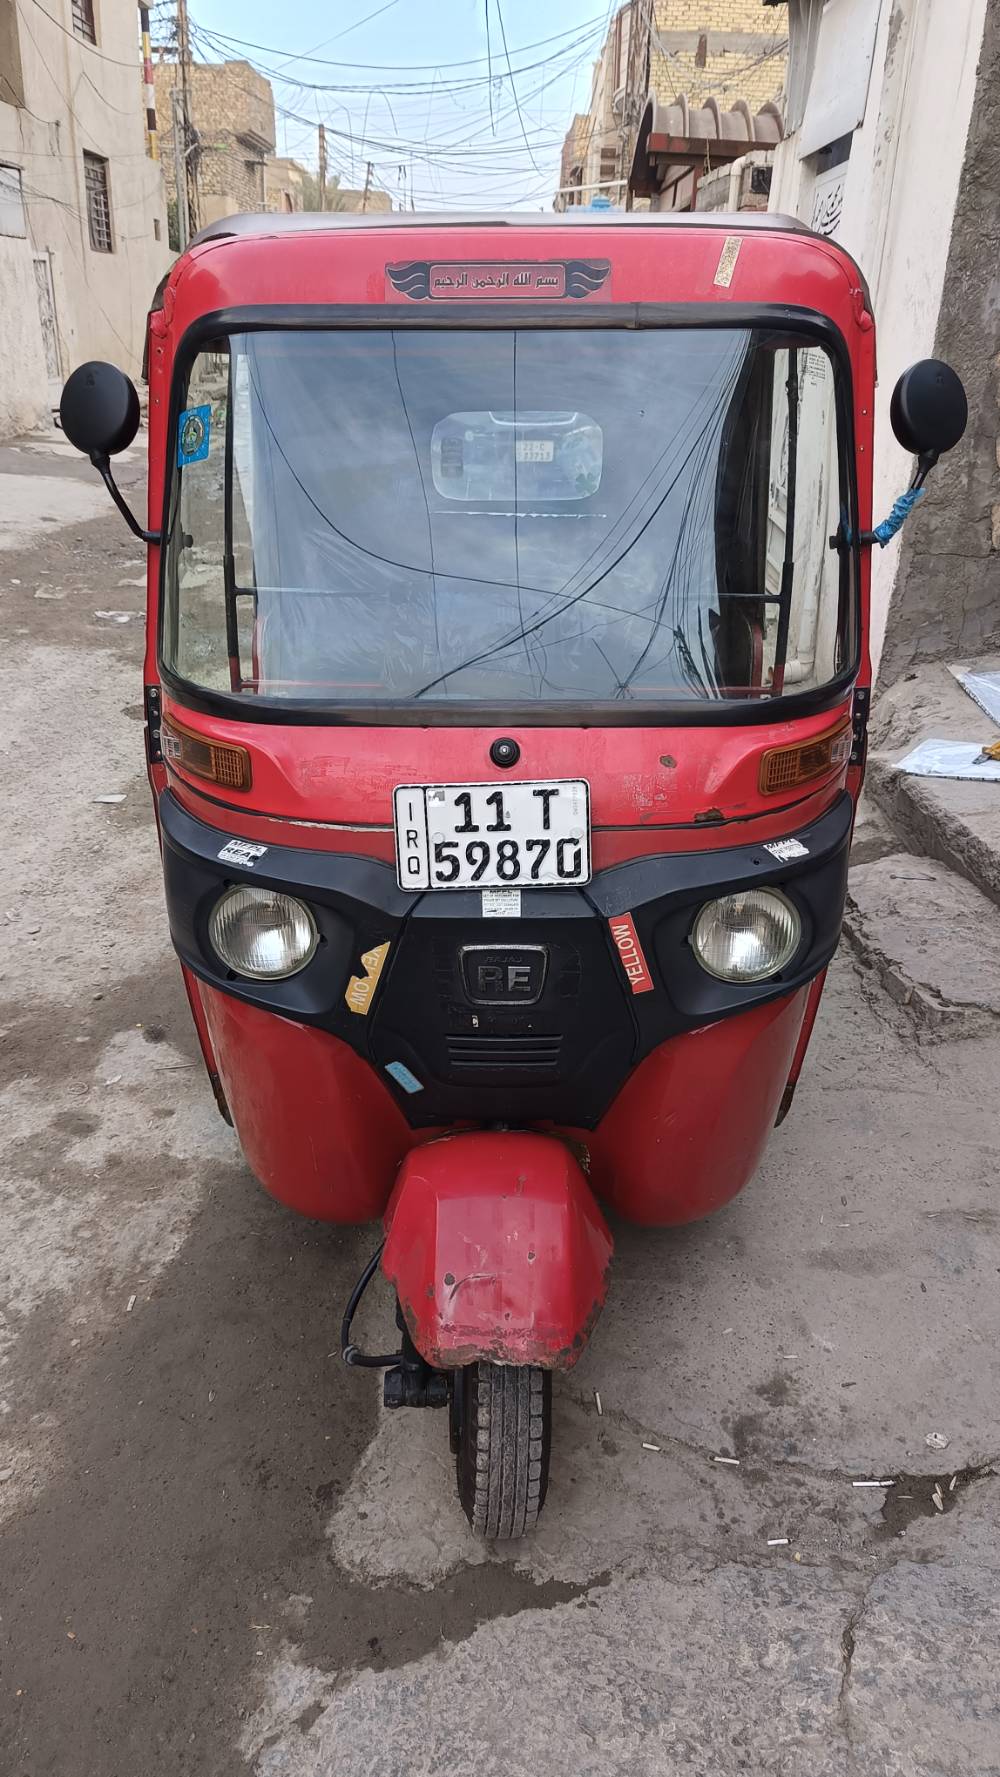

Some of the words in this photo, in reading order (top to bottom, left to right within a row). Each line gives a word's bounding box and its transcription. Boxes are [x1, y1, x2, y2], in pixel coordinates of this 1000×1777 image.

[434, 271, 468, 289] الرحيم
[471, 272, 510, 289] الرحمن
[513, 271, 531, 288] الله
[536, 275, 560, 288] بسم
[454, 791, 512, 833] 11
[533, 788, 560, 830] T
[406, 802, 420, 875] IRQ
[434, 837, 582, 882] 59870
[612, 924, 645, 985] YELLOW
[478, 965, 531, 992] RE
